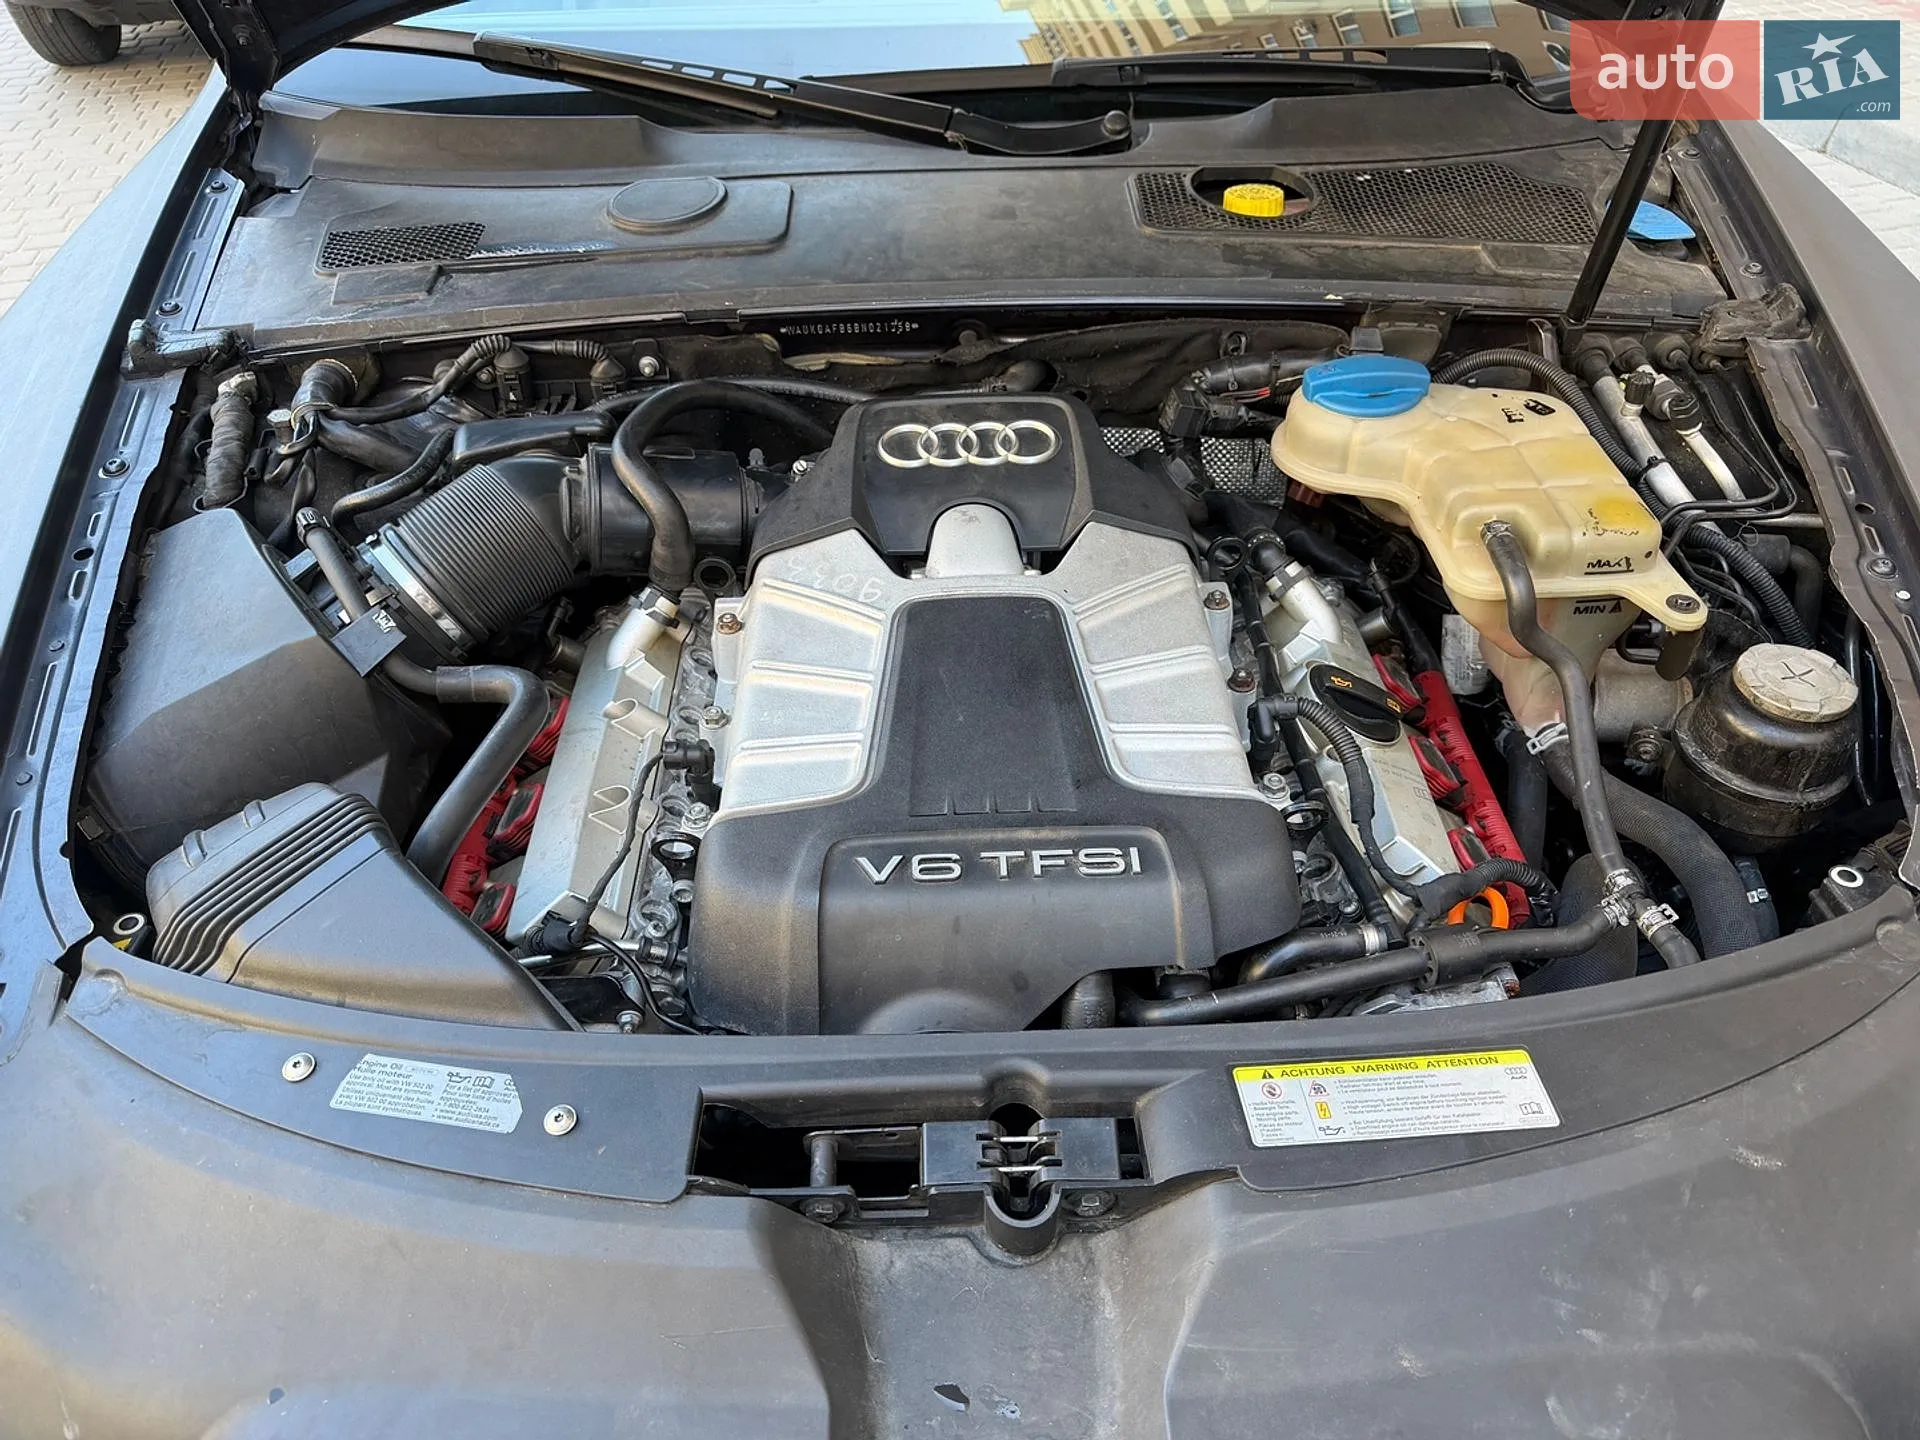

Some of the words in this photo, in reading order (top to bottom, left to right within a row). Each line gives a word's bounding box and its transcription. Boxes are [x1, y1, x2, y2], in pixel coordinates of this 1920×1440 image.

[1587, 558, 1623, 569] MAX
[1573, 605, 1606, 615] MIN
[853, 852, 962, 886] V6
[979, 846, 1142, 881] TFSI
[1280, 1065, 1346, 1078] ACHTUNG
[1351, 1061, 1419, 1073] WARNING
[1426, 1056, 1499, 1069] ATTENTION
